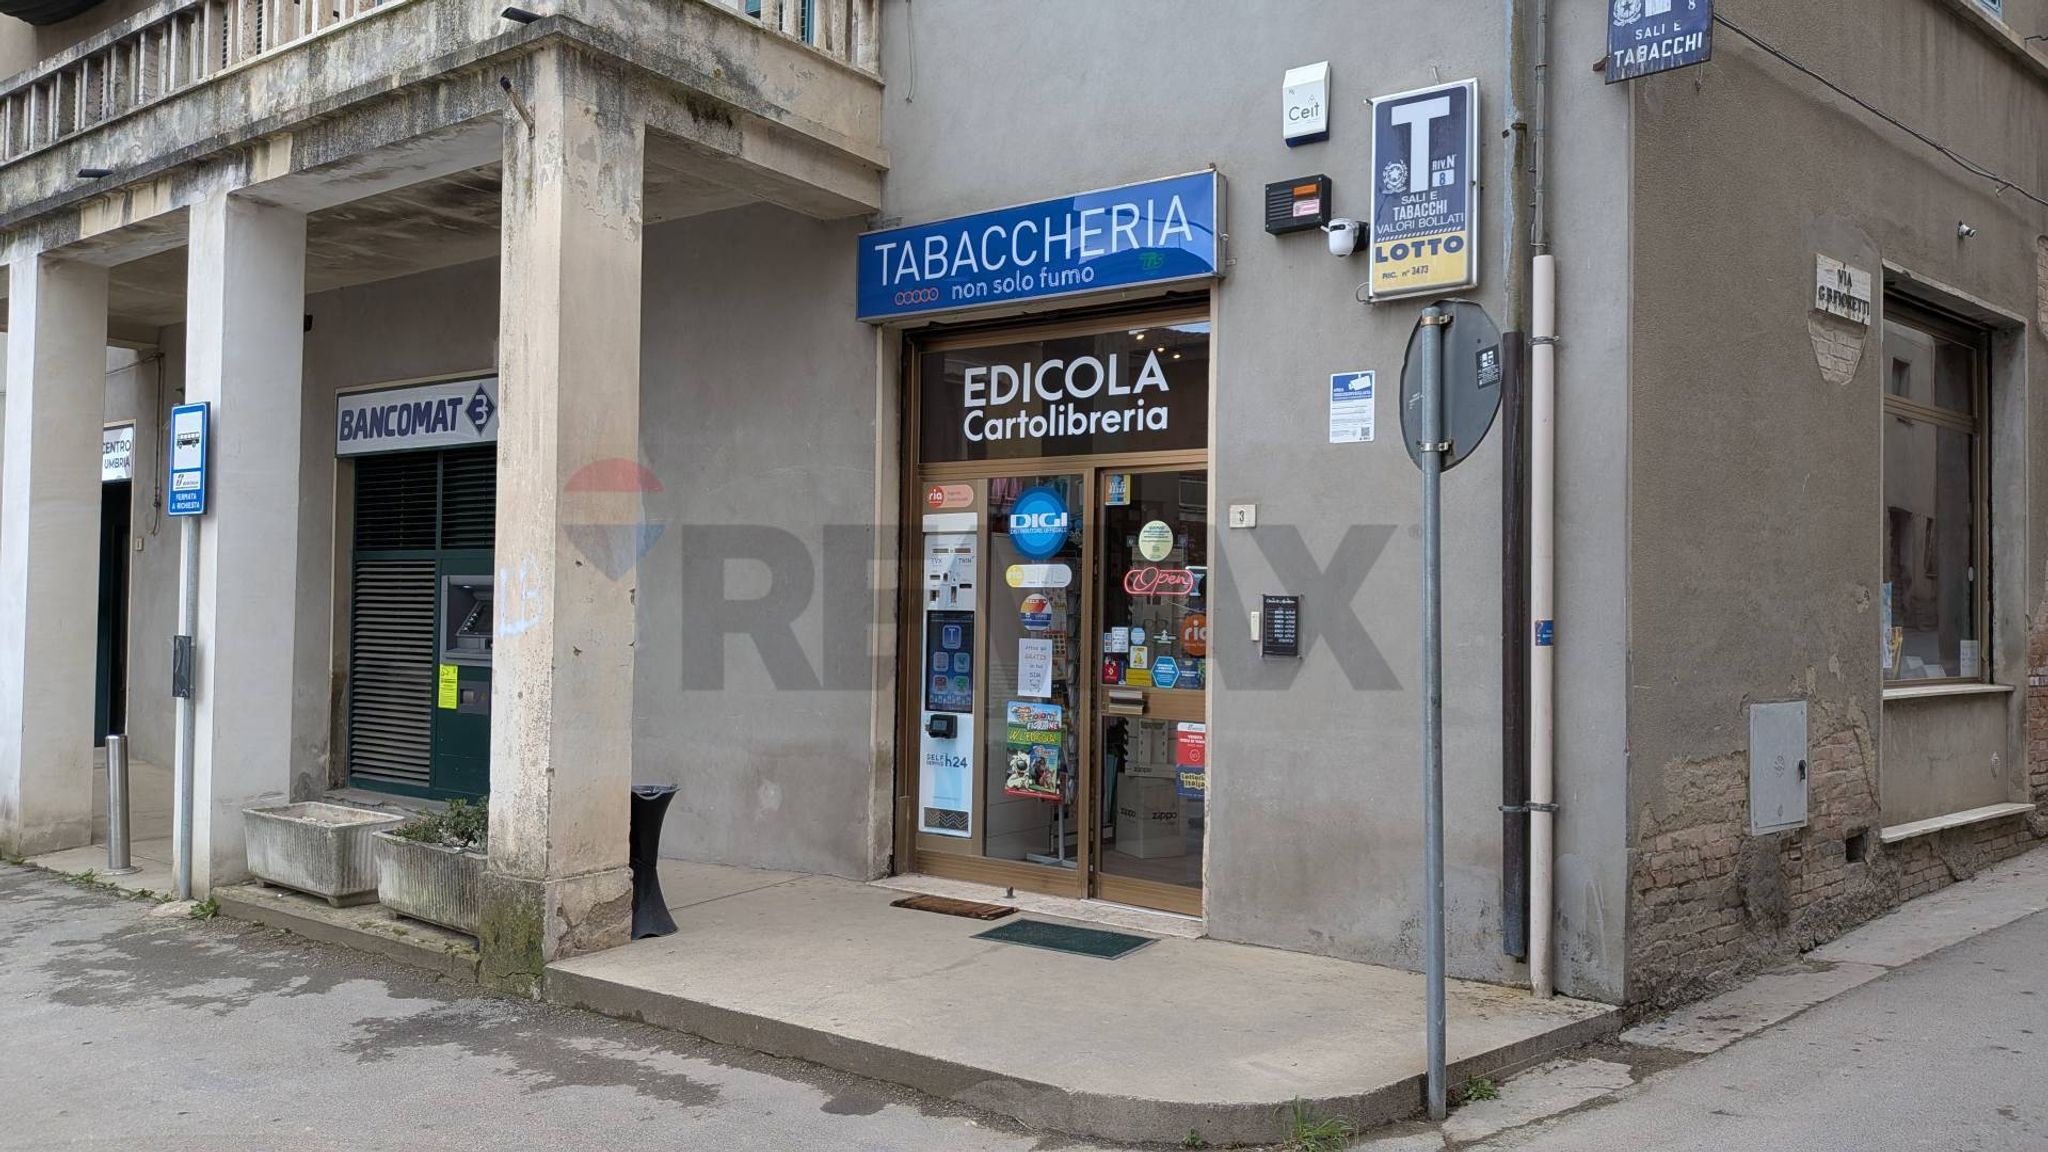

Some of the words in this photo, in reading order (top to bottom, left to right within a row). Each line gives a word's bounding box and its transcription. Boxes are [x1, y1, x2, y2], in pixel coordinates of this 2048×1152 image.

[1635, 24, 1665, 40] SALI
[1674, 21, 1681, 31] E
[1614, 32, 1702, 68] TABACCHI
[1289, 102, 1319, 121] Ceit
[1391, 96, 1450, 193] T
[1439, 172, 1446, 185] 8
[1401, 192, 1426, 205] SALI
[1430, 191, 1438, 200] E
[1393, 199, 1447, 221] TABACCHI
[1376, 221, 1415, 234] VALORI
[1419, 212, 1464, 228] BOLLATI
[874, 195, 1193, 287] TABACCHERIA
[1375, 235, 1464, 263] LOTTO
[952, 282, 988, 301] non
[993, 271, 1033, 295] solo
[1039, 266, 1095, 289] fumo
[1837, 268, 1853, 288] VIA
[965, 350, 1169, 407] EDICOLA
[339, 397, 463, 441] BANCOMAT
[963, 399, 1169, 442] Cartolibreria
[104, 456, 130, 469] UMBRIA
[929, 489, 943, 501] ria
[1010, 512, 1068, 528] DIGI
[1239, 510, 1245, 521] 3
[1133, 567, 1189, 596] Open
[1151, 811, 1177, 821] zippo
